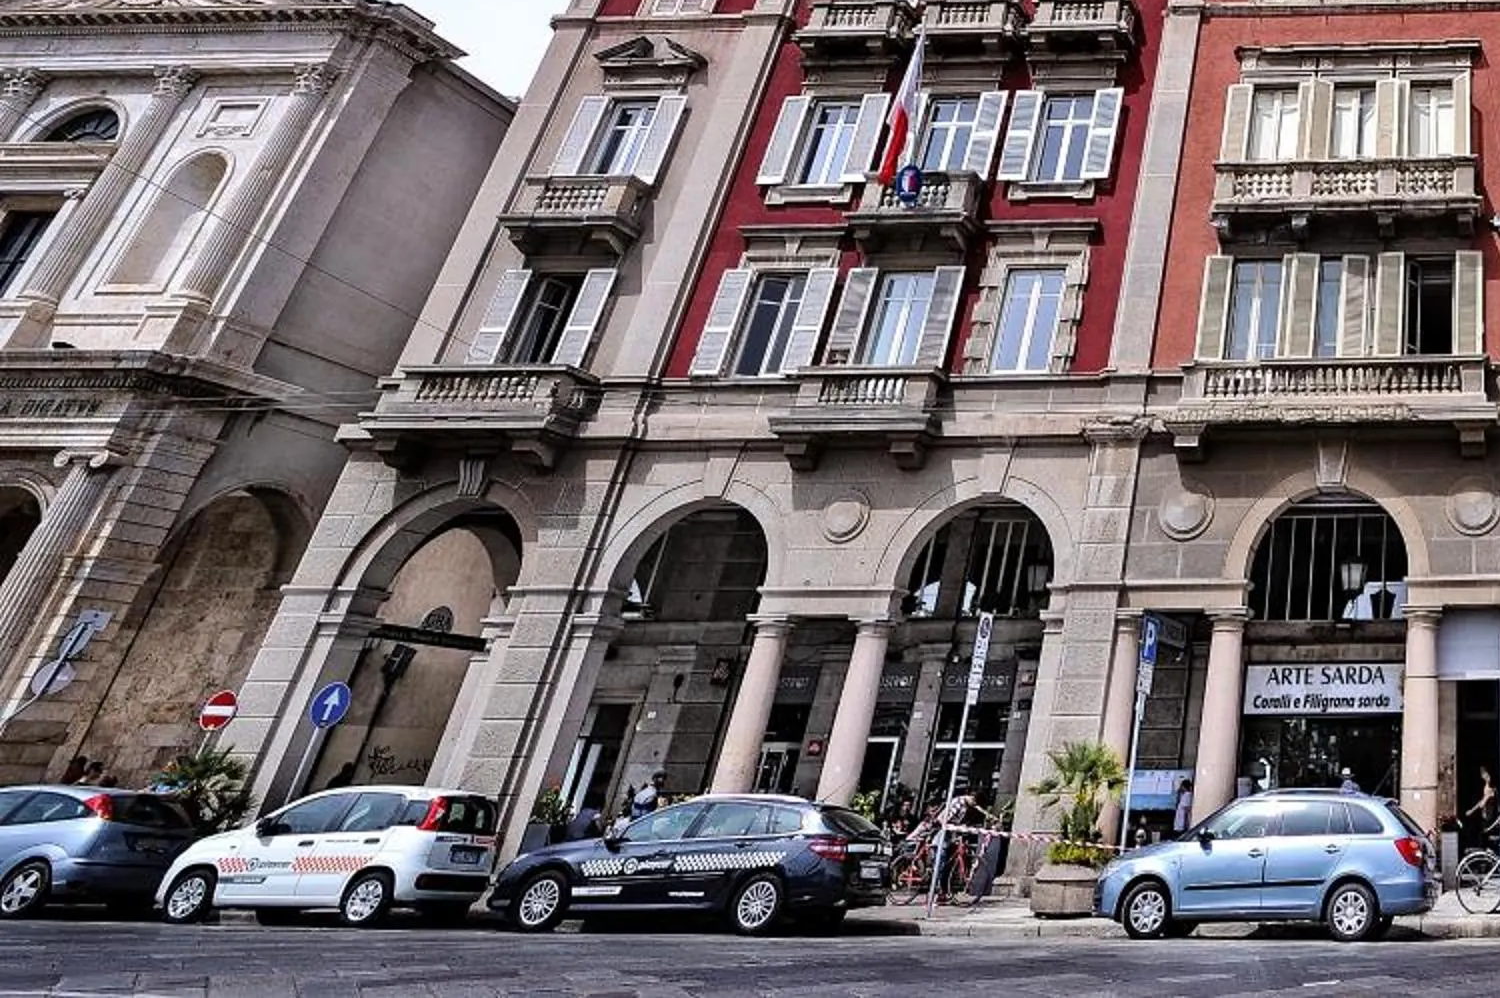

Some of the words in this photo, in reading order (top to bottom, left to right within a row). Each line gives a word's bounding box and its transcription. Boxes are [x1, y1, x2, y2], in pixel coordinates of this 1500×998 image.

[1266, 666, 1314, 685] ARTE
[1320, 665, 1386, 685] SARDA
[1253, 694, 1291, 709] Coralli
[1293, 697, 1301, 709] e
[1303, 694, 1355, 713] Filigrana
[1357, 694, 1391, 708] sarda
